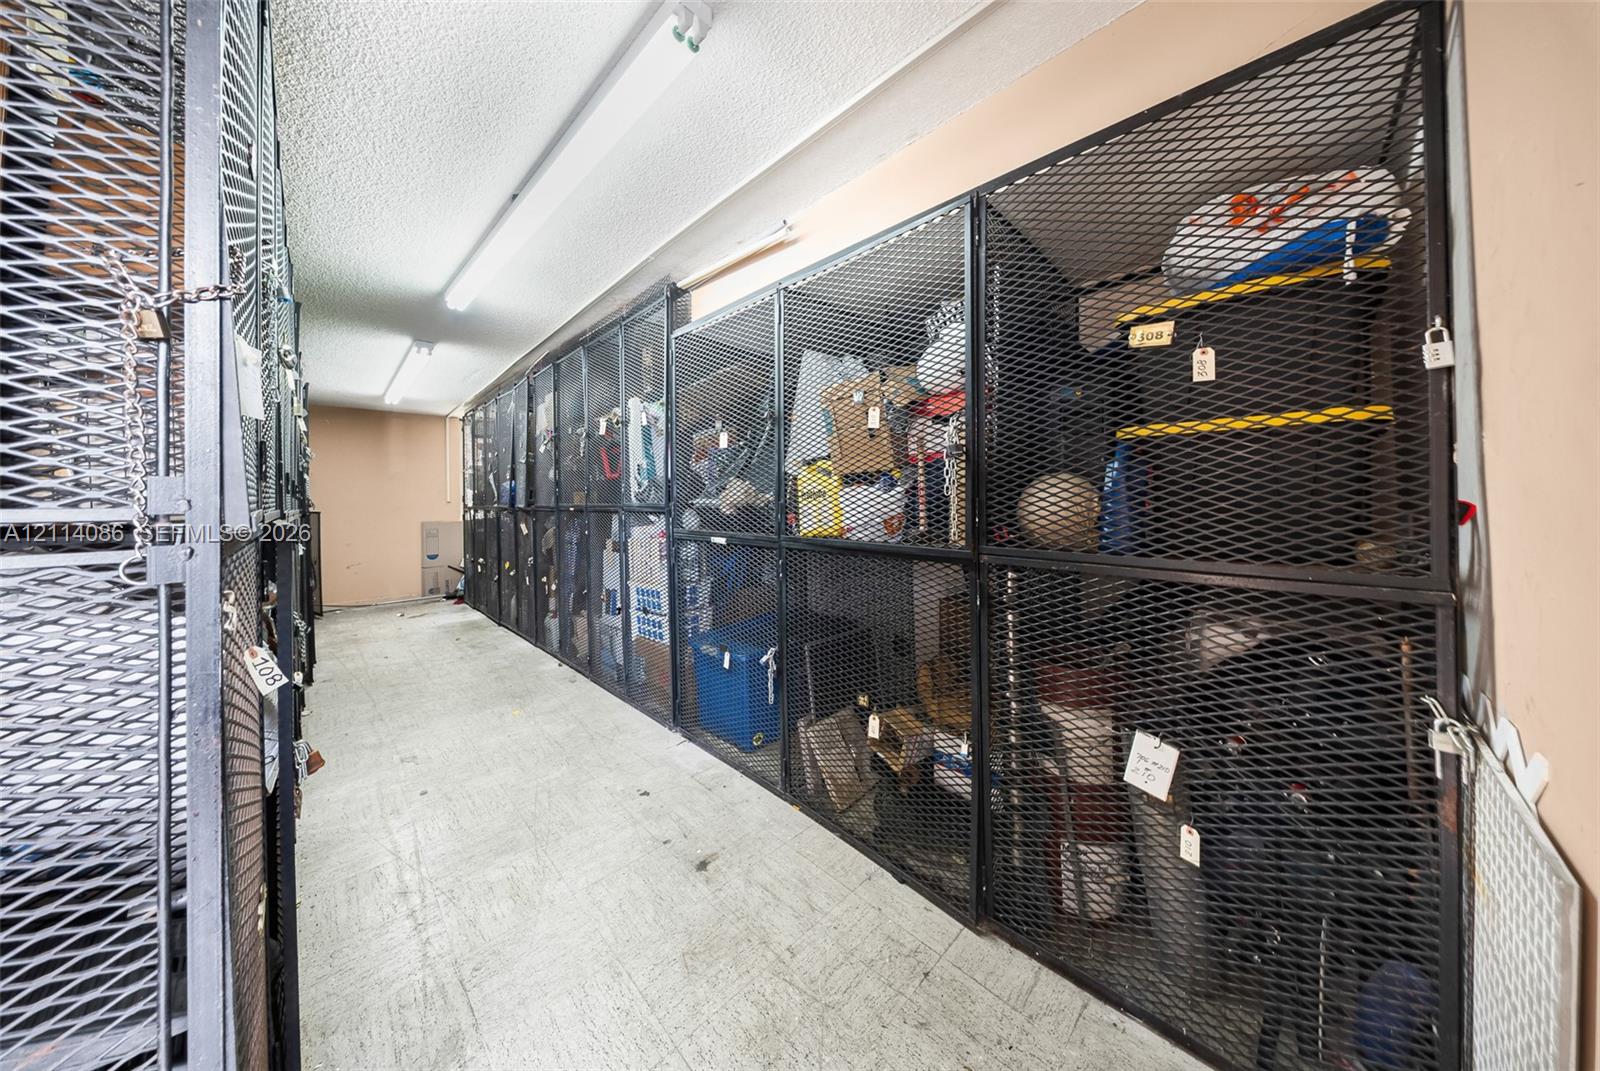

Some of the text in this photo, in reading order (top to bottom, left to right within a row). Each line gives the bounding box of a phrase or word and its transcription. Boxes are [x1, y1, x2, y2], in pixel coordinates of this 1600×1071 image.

[1138, 330, 1164, 342] 308
[1197, 359, 1208, 378] 308
[252, 655, 283, 687] 108
